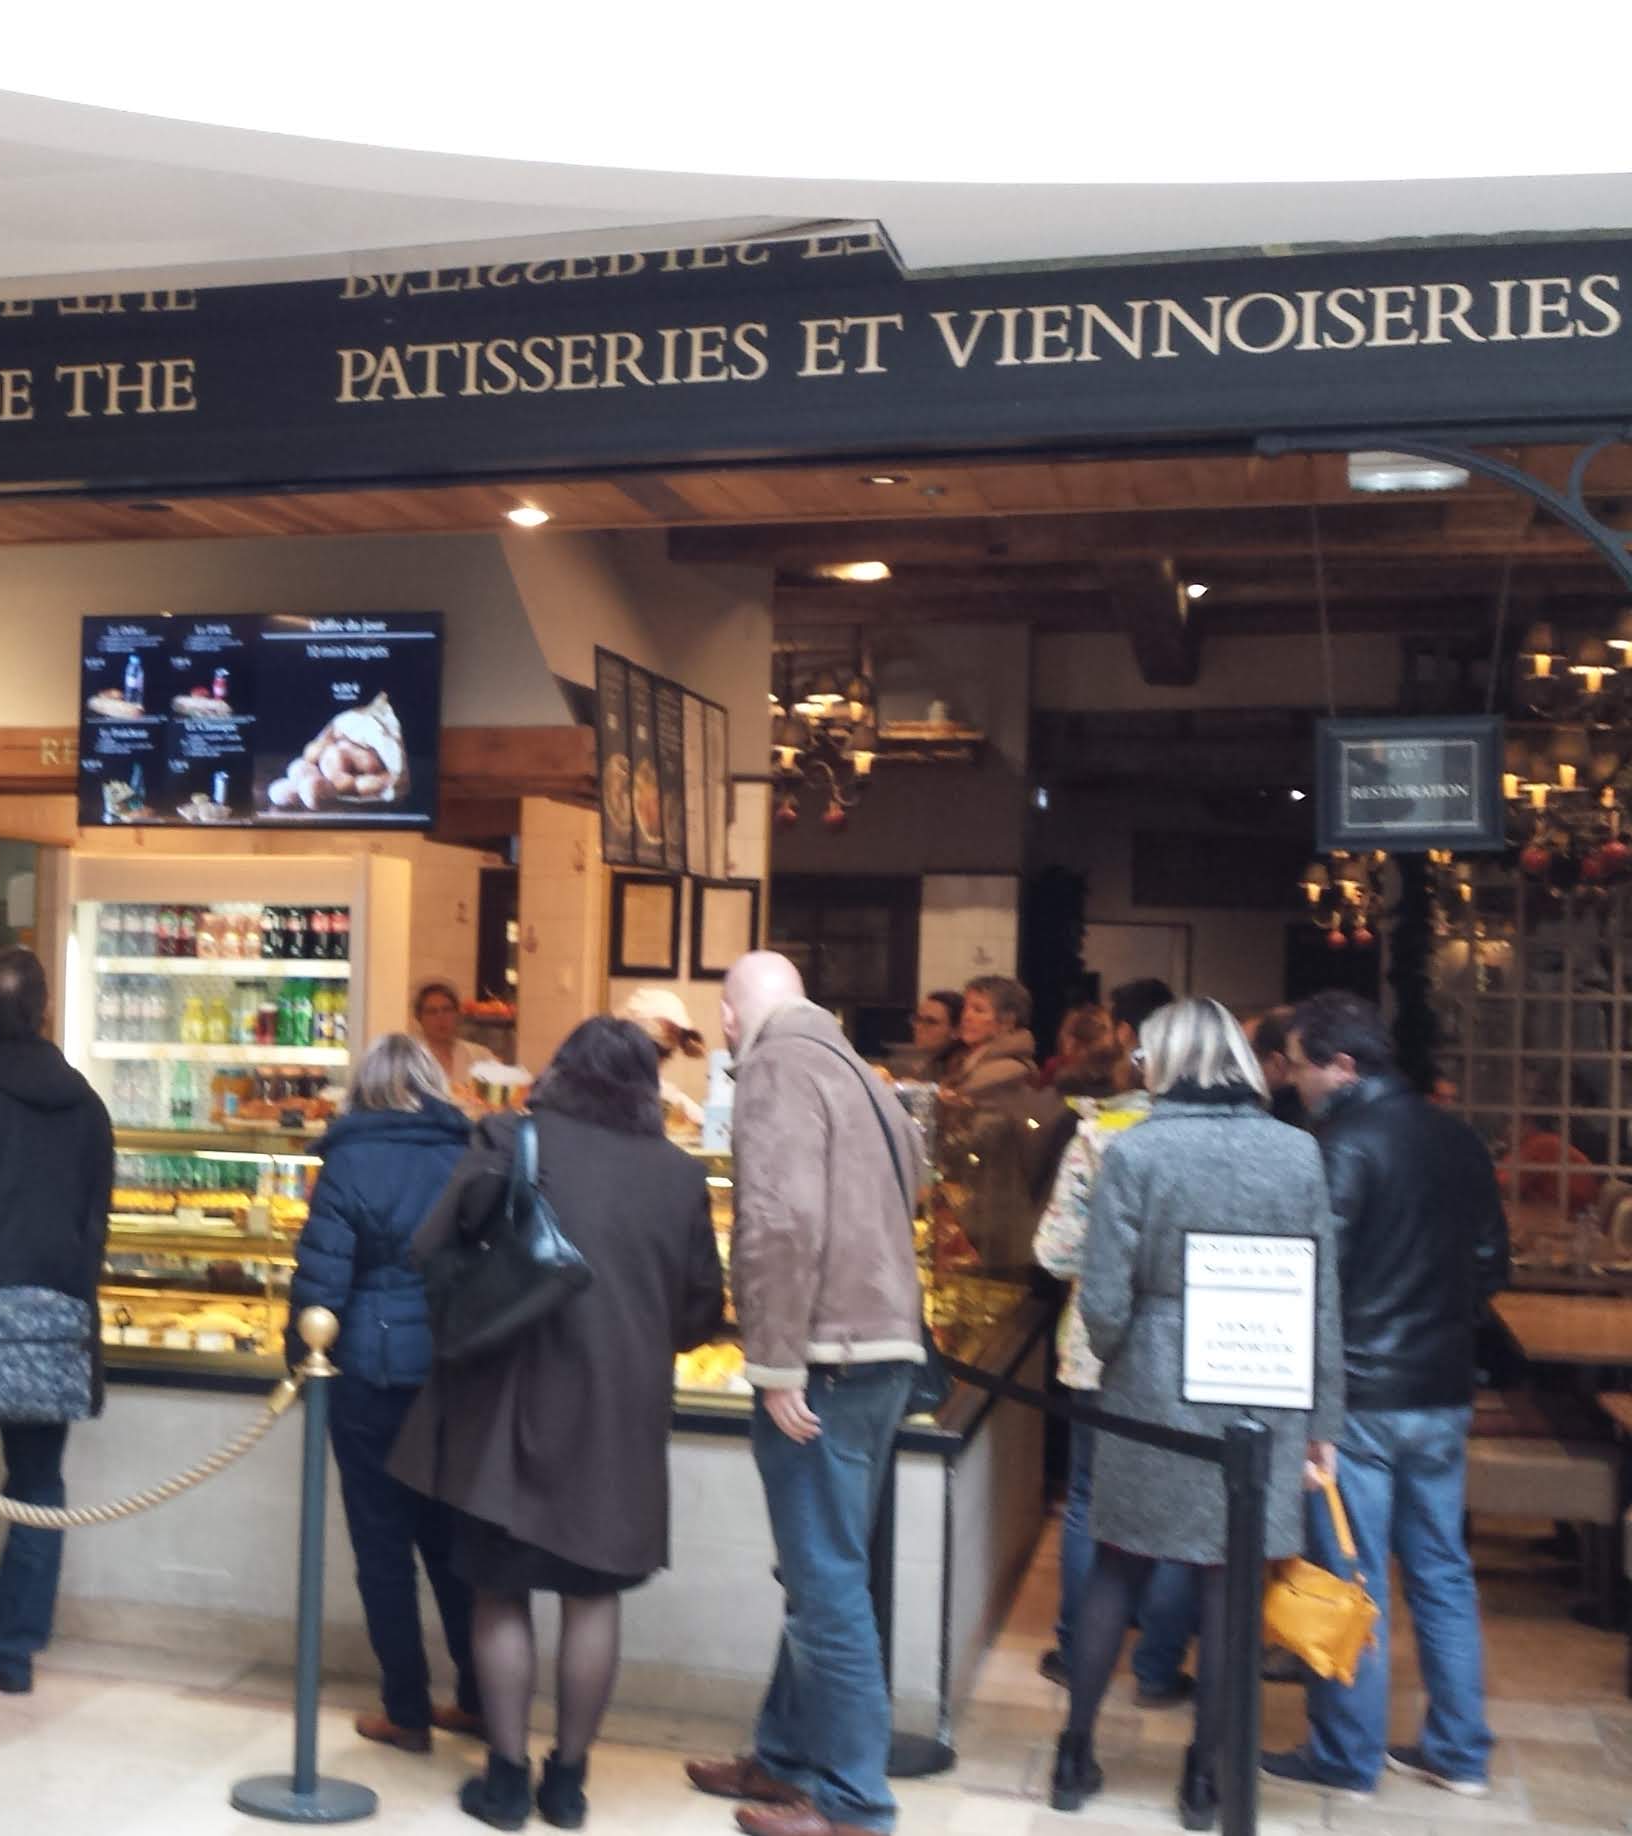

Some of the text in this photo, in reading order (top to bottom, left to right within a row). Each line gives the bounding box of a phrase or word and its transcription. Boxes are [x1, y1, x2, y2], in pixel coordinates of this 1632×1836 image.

[335, 273, 1622, 404] PATISSERIES ET VIENNOISERIES
[56, 358, 198, 417] THE
[1350, 783, 1471, 800] RESTAURATION
